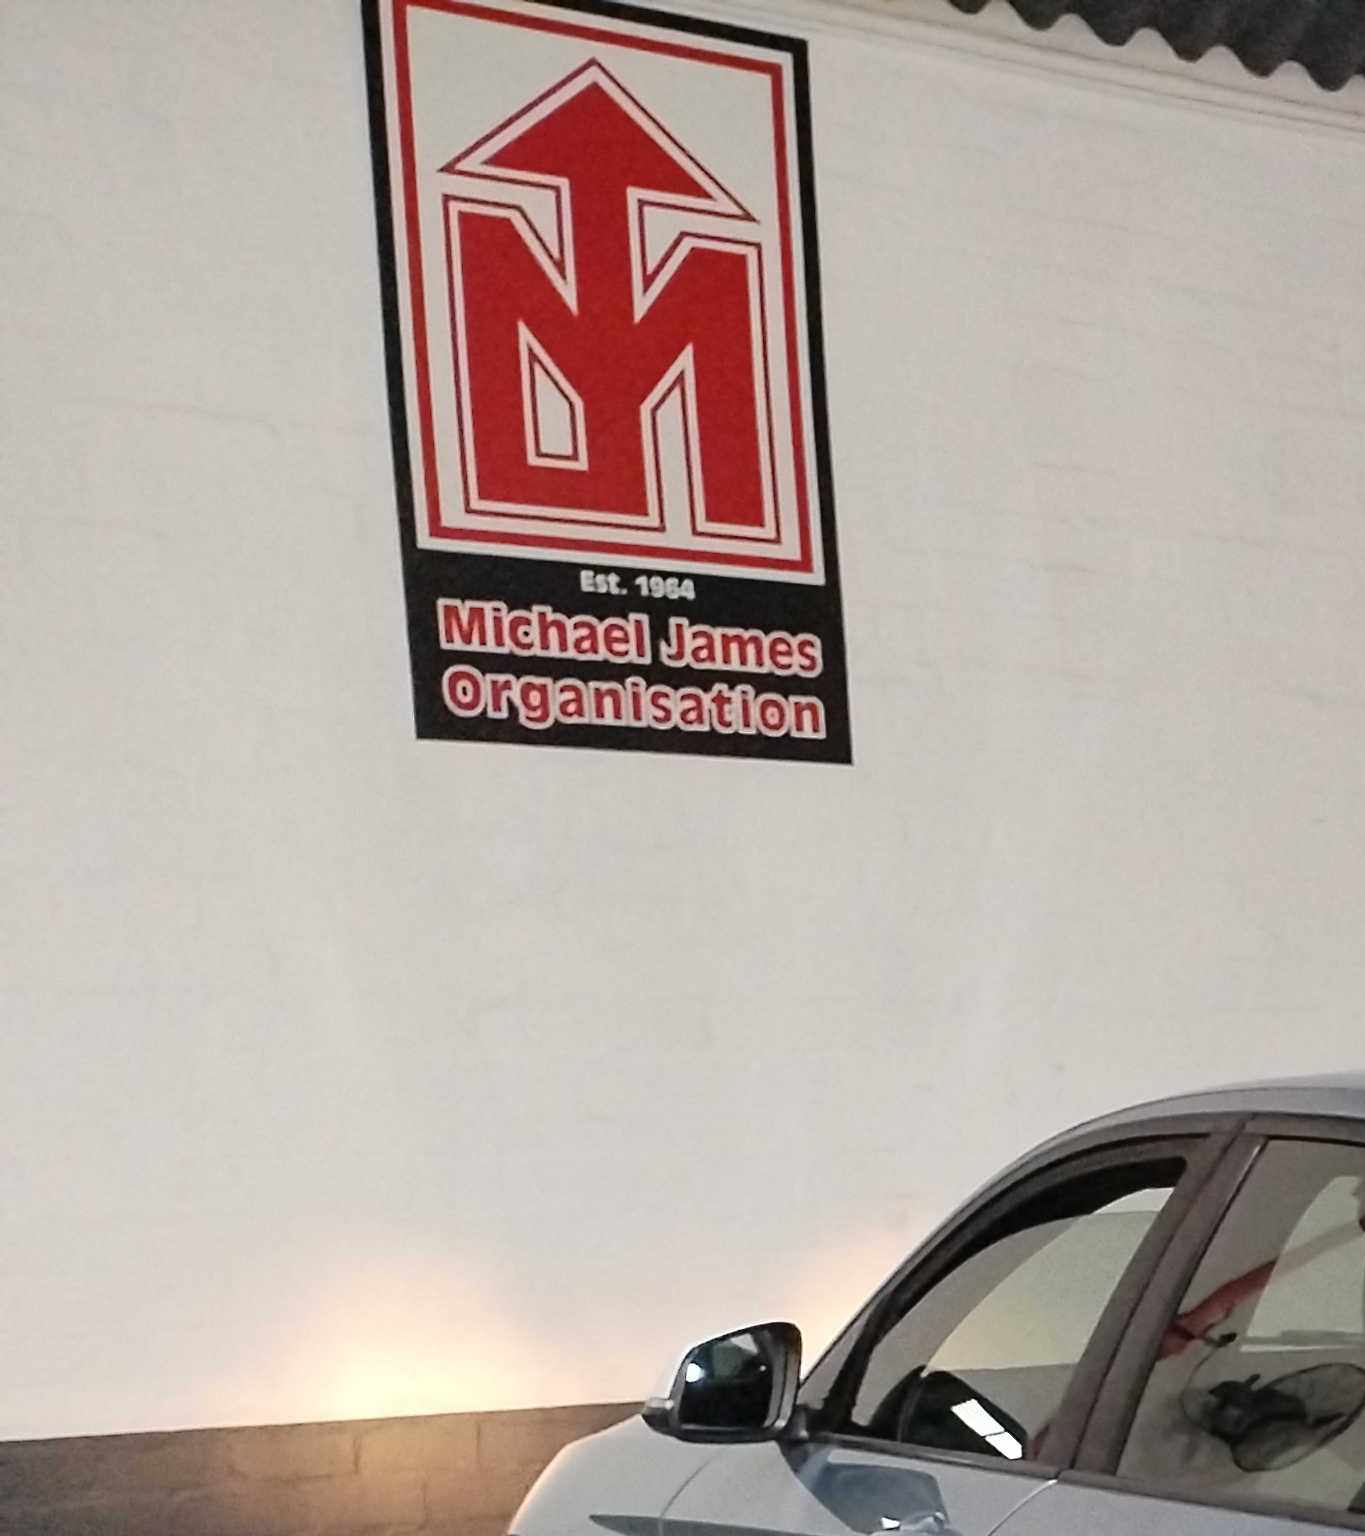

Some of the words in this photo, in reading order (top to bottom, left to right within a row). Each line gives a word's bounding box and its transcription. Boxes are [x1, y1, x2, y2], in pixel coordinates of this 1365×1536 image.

[580, 569, 628, 596] Est.
[635, 574, 695, 600] 1964
[437, 597, 652, 666] Michael
[658, 615, 824, 679] James
[441, 663, 827, 740] Organisation
